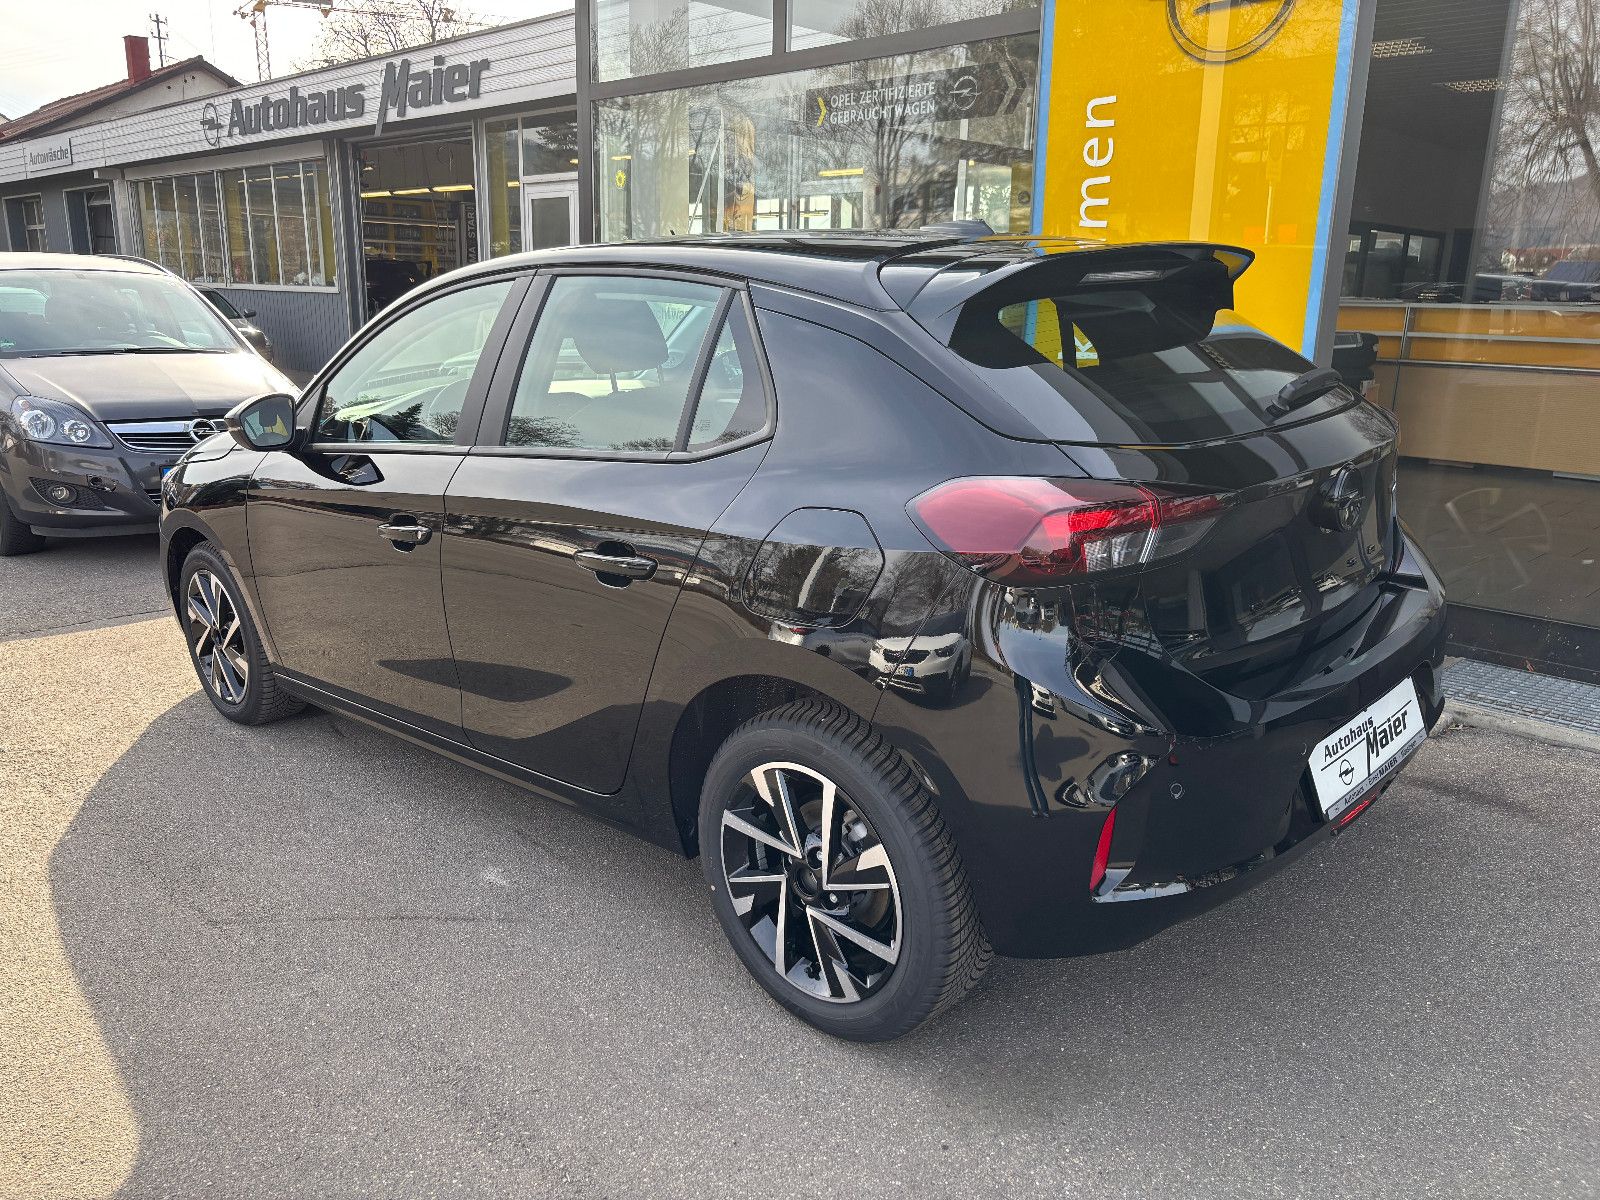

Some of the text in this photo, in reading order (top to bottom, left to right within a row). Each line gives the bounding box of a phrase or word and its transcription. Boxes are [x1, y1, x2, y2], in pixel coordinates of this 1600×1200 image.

[227, 55, 490, 137] Autohaus Maier
[830, 81, 936, 108] OPEL ZERTIFIZIERTE
[829, 100, 936, 125] GEBRAUCHTWAGEN
[29, 145, 69, 166] Autowäsche
[1078, 95, 1117, 246] men
[1324, 709, 1408, 777] Autohaus Maier
[1379, 757, 1398, 778] MAIER
